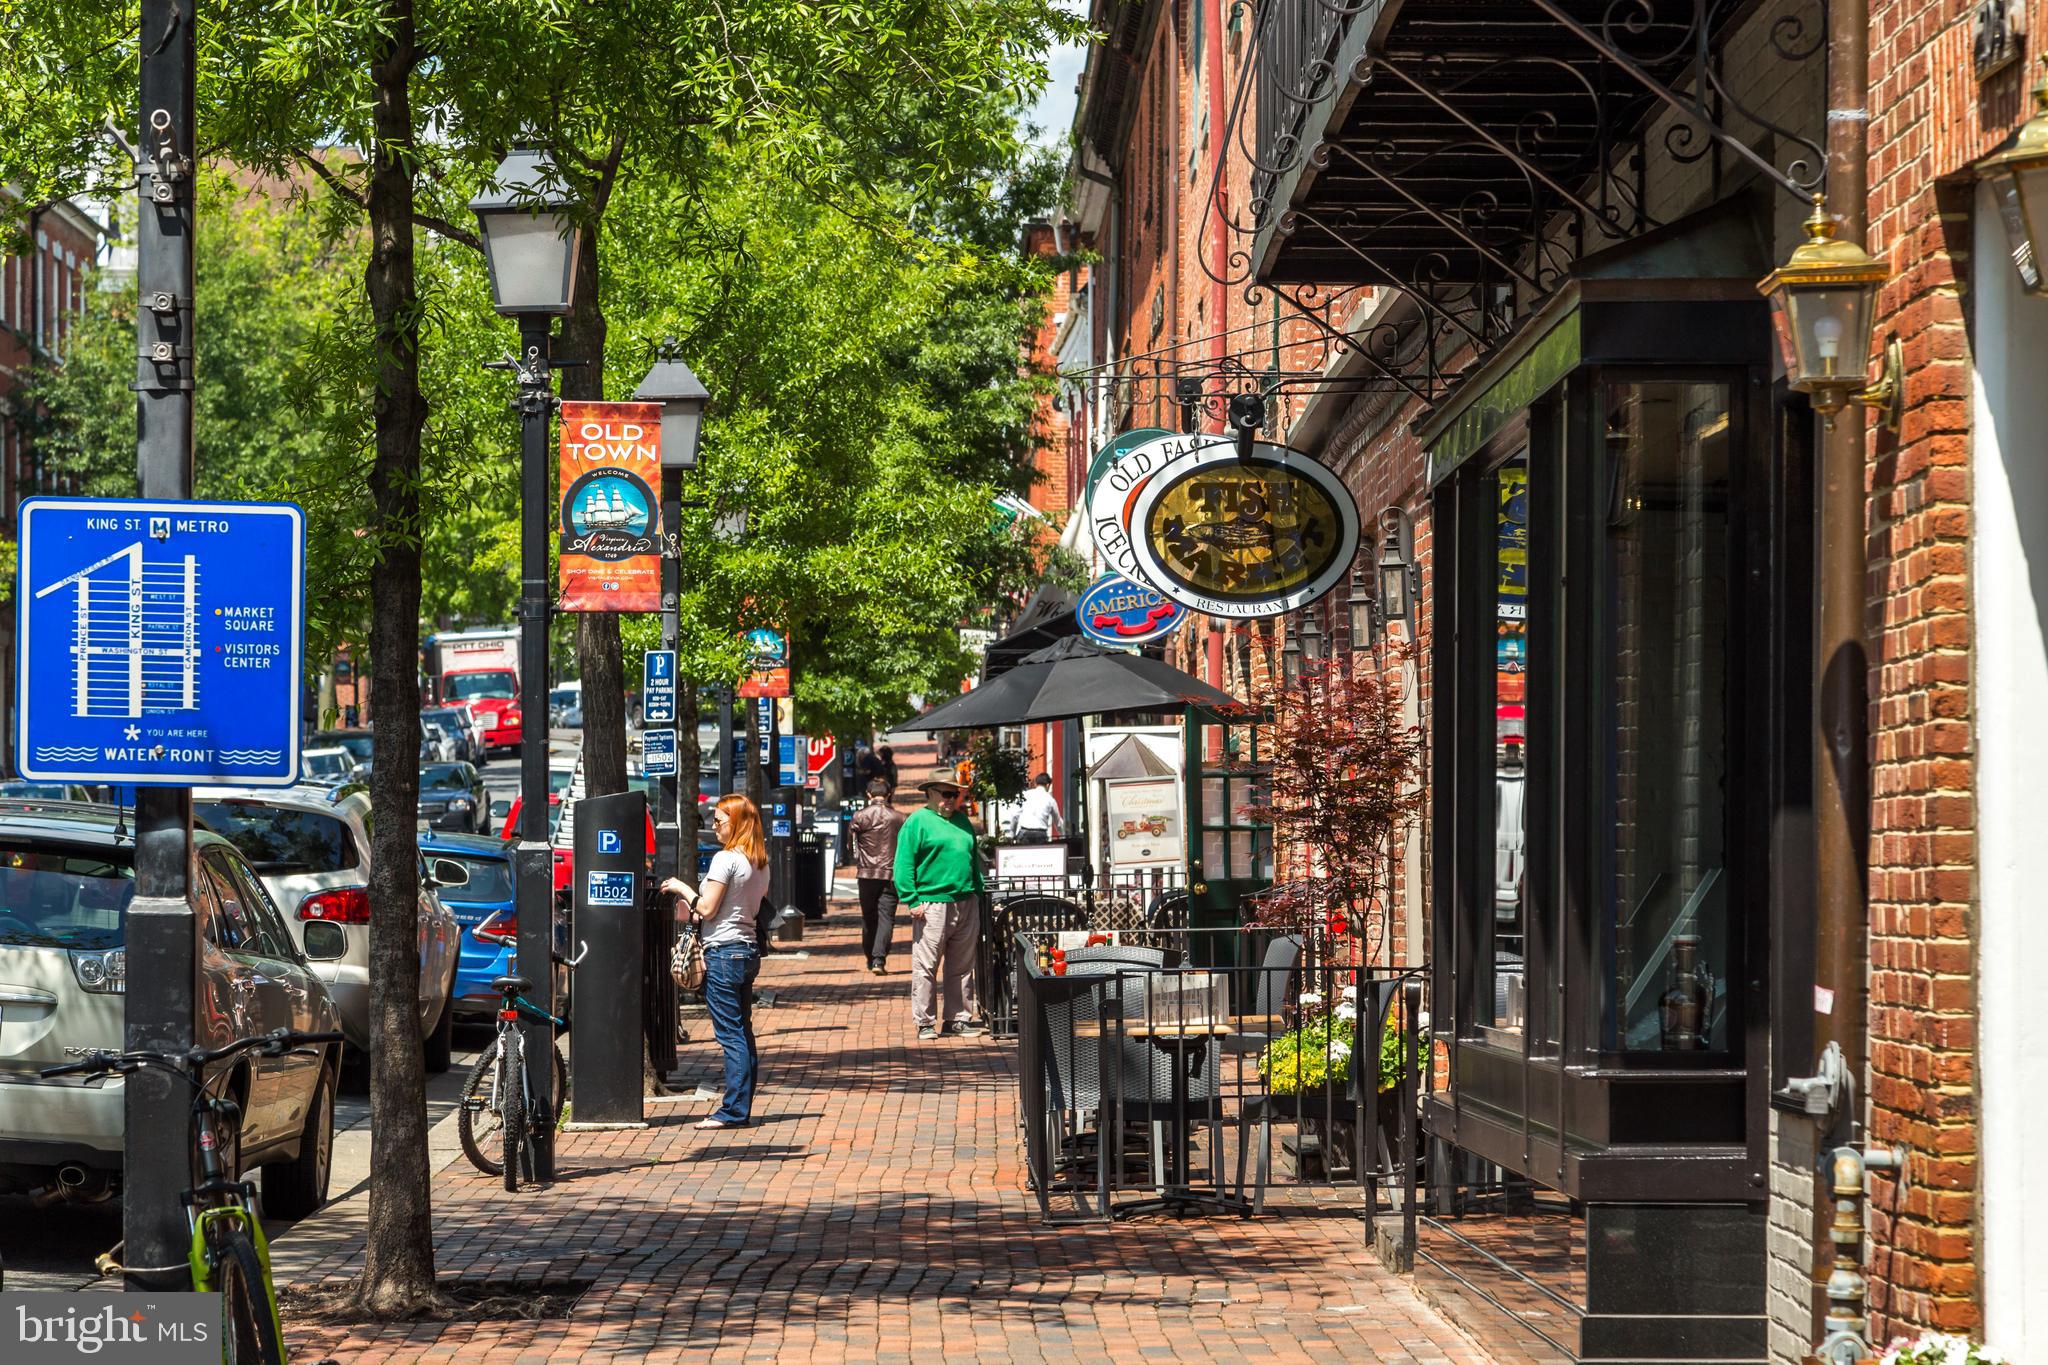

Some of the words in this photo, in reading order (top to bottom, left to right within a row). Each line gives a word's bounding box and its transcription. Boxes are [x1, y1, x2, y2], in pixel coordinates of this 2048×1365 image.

[580, 423, 644, 441] OLD
[566, 443, 656, 461] TOWN
[591, 469, 629, 478] WELCOME
[1109, 453, 1151, 491] OLD
[87, 518, 118, 530] KING
[124, 518, 142, 531] ST.
[176, 520, 229, 533] METRO
[568, 531, 652, 553] Alexandria
[131, 578, 140, 596] ST
[80, 607, 87, 618] ST
[185, 607, 192, 617] ST
[224, 606, 275, 618] MARKET
[1196, 598, 1291, 615] RESTAURANT
[131, 604, 140, 638] KING
[224, 619, 275, 631] SQUARE
[224, 643, 280, 655] VISITORS
[478, 640, 505, 649] OHIO
[223, 656, 271, 668] CENTER
[655, 655, 665, 676] P
[650, 678, 655, 686] 2
[655, 678, 669, 686] HOUR
[655, 686, 673, 694] PARKING
[146, 729, 164, 737] YOU
[167, 729, 184, 737] ARE
[186, 729, 208, 738] HERE
[807, 737, 831, 756] OP
[776, 804, 783, 814] P
[602, 832, 617, 851] P
[592, 886, 628, 898] 11502
